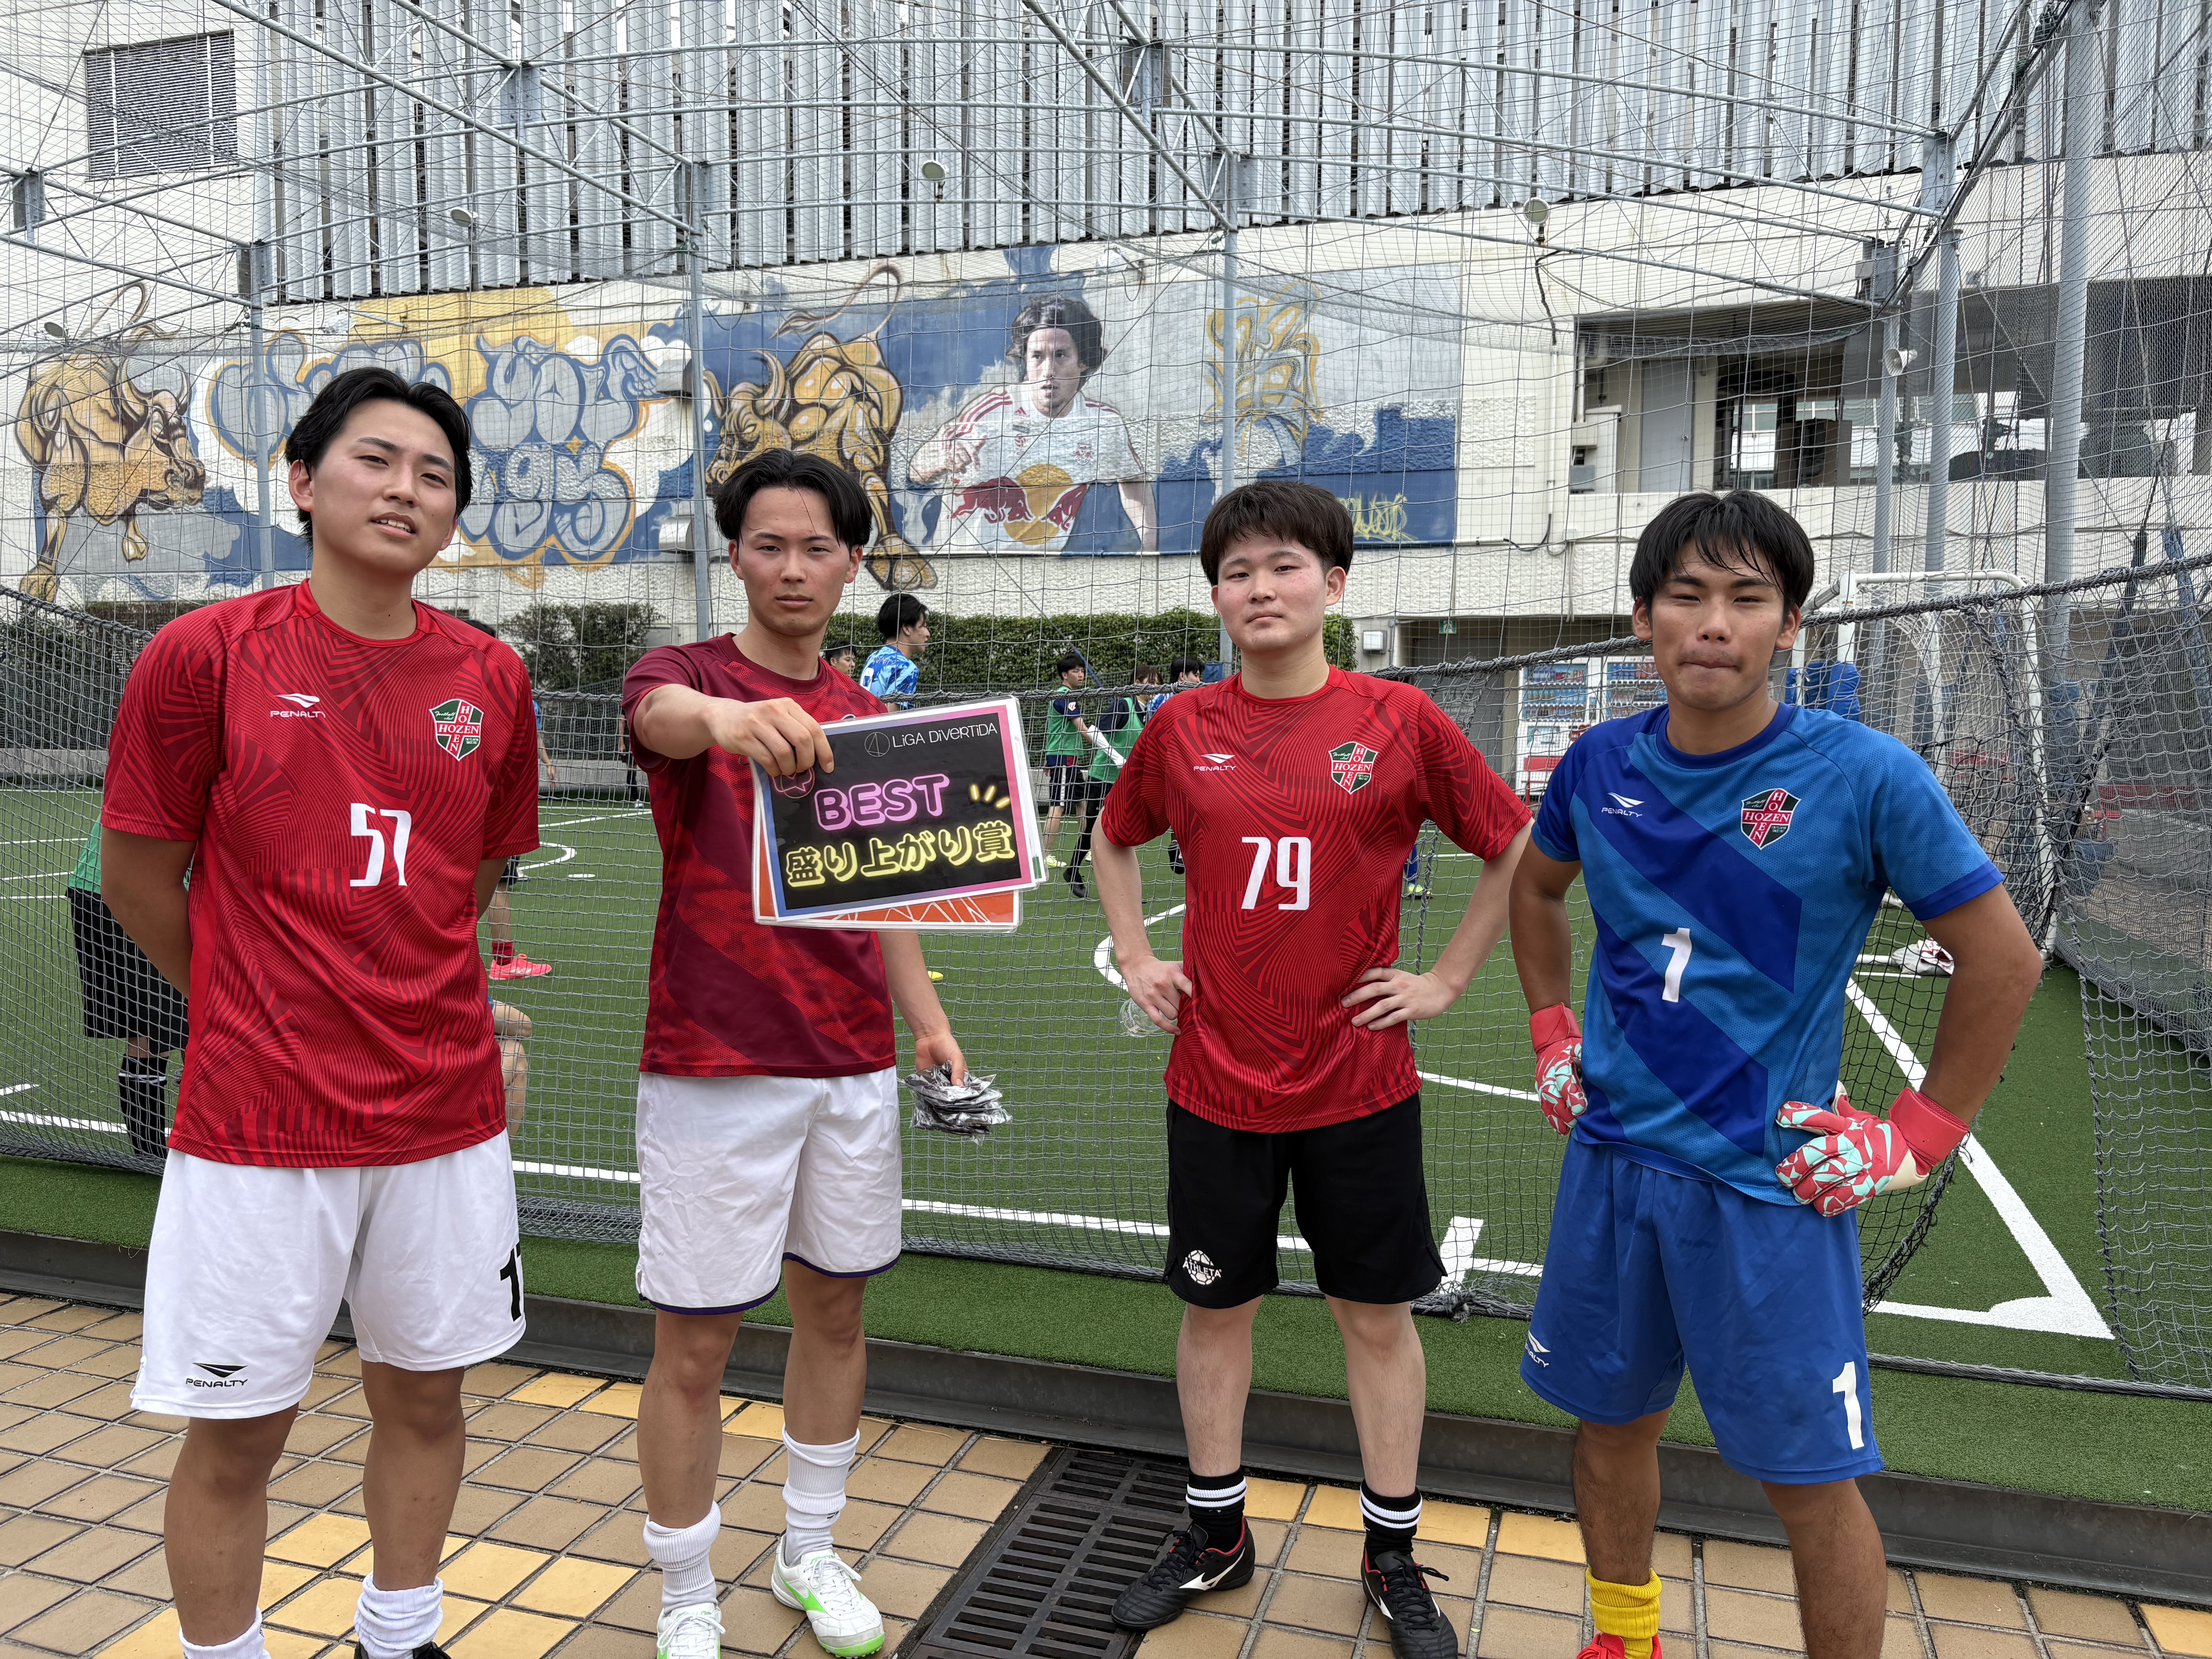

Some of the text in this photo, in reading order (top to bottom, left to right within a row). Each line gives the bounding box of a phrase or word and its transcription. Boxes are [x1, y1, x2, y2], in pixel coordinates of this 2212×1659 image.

[438, 724, 480, 734] HOZEN
[1334, 763, 1371, 771] HOZEN
[814, 774, 950, 831] BEST
[1602, 807, 1643, 817] PENALTY
[1744, 812, 1790, 822] HOZEN
[350, 803, 412, 887] 57
[786, 820, 1015, 887] 盛り上がり賞
[1241, 836, 1311, 910] 79
[1661, 927, 1692, 1003] 1
[500, 1242, 521, 1322] 1
[186, 1378, 248, 1388] PENALTY
[1832, 1361, 1865, 1450] 1
